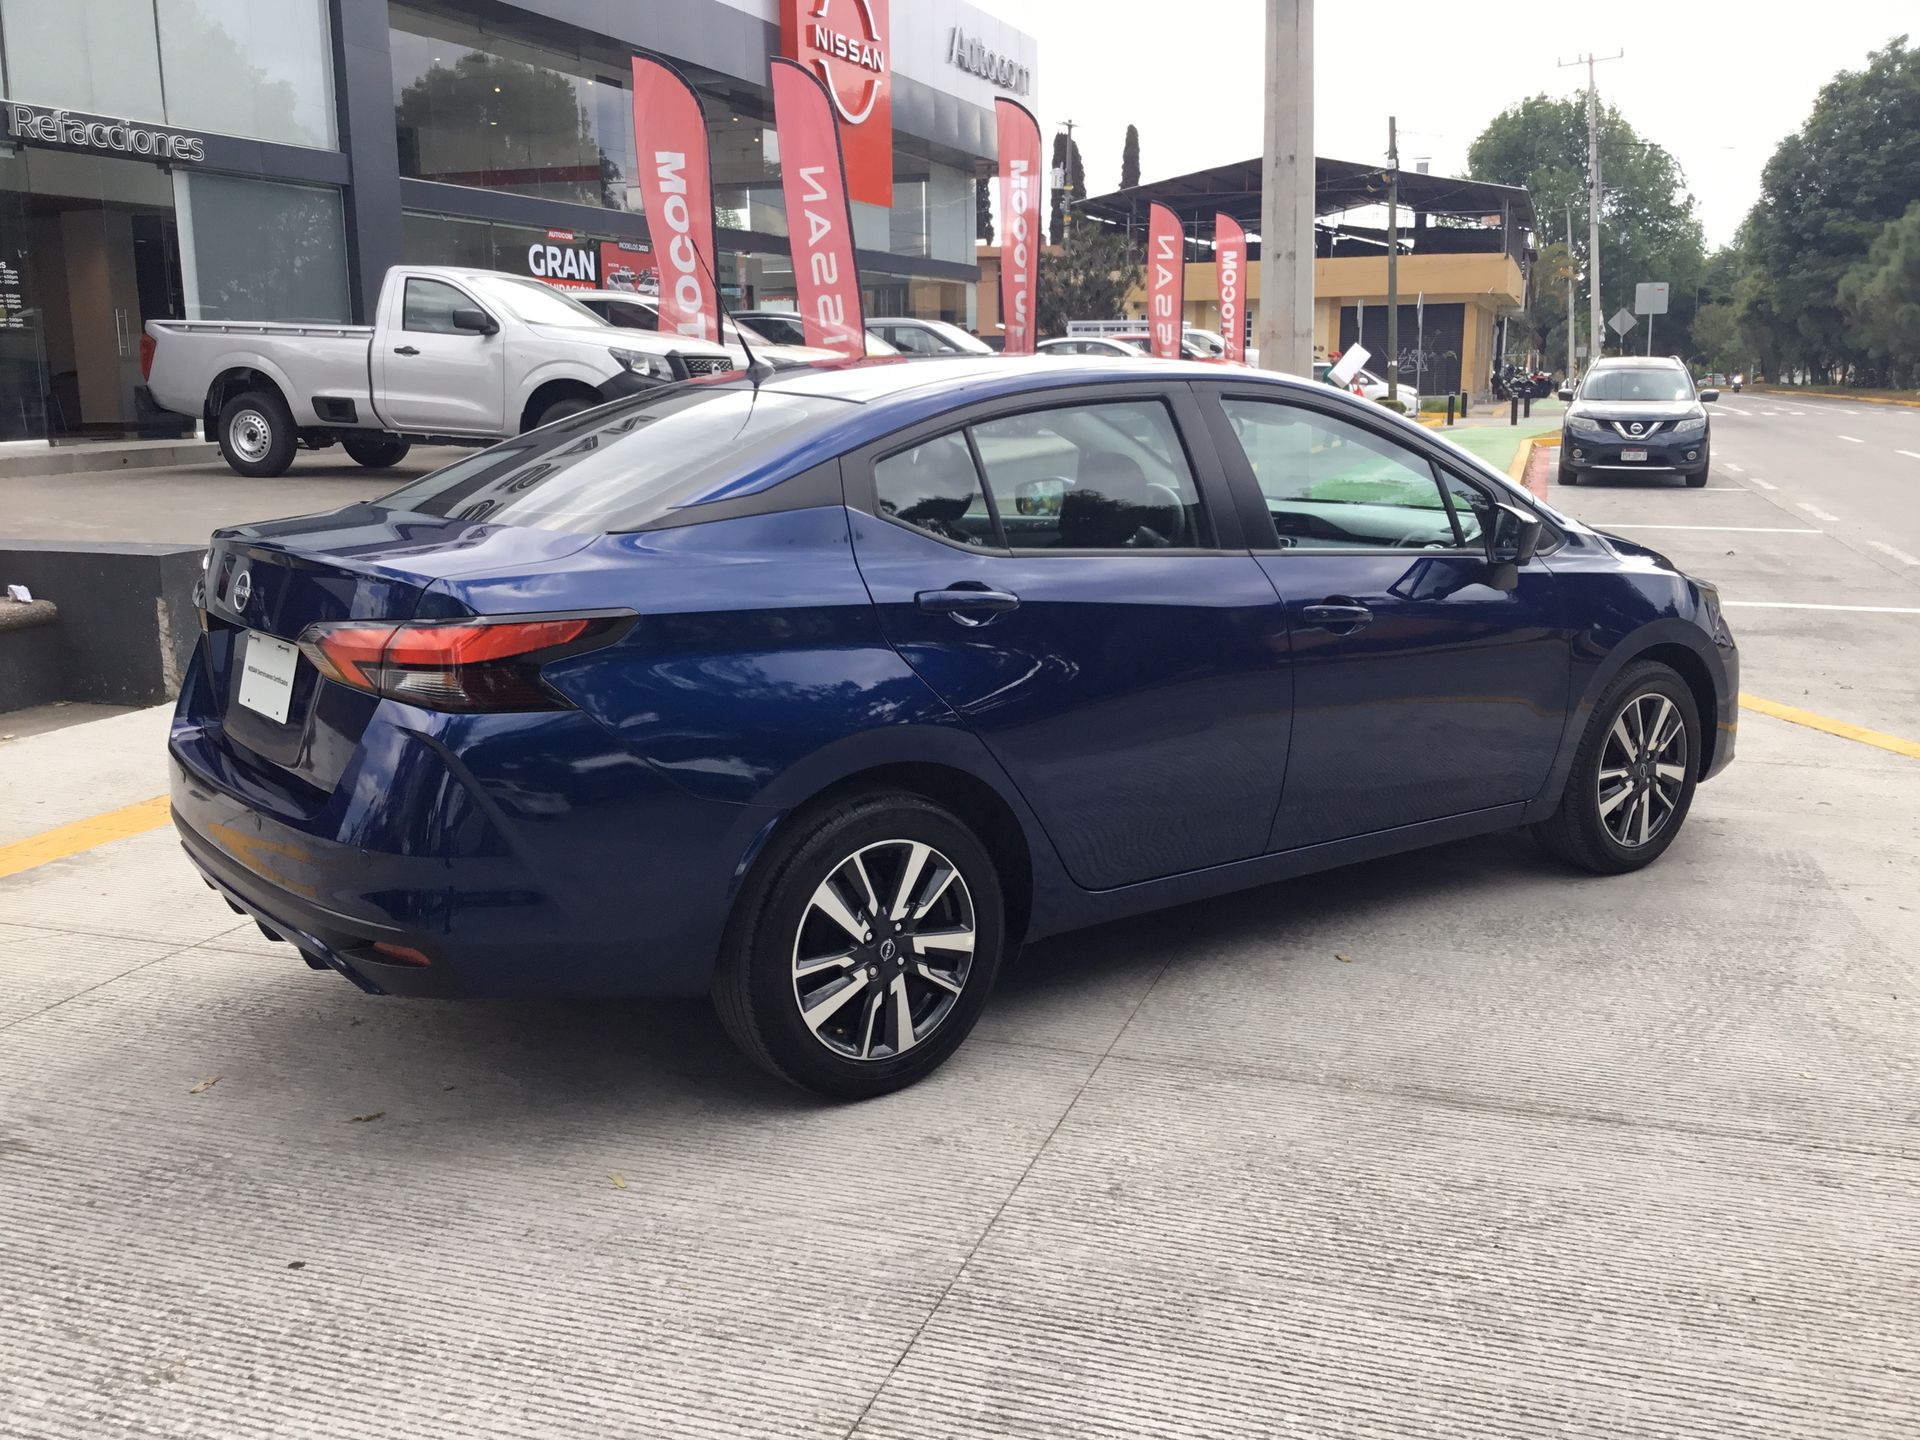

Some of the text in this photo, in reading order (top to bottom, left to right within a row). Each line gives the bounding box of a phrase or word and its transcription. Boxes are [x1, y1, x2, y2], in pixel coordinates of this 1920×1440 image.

[814, 23, 885, 73] NISSAN
[947, 25, 1031, 96] Autocom
[10, 104, 206, 162] Refacciones
[548, 230, 574, 240] AUTOCOM
[528, 243, 596, 281] GRAN
